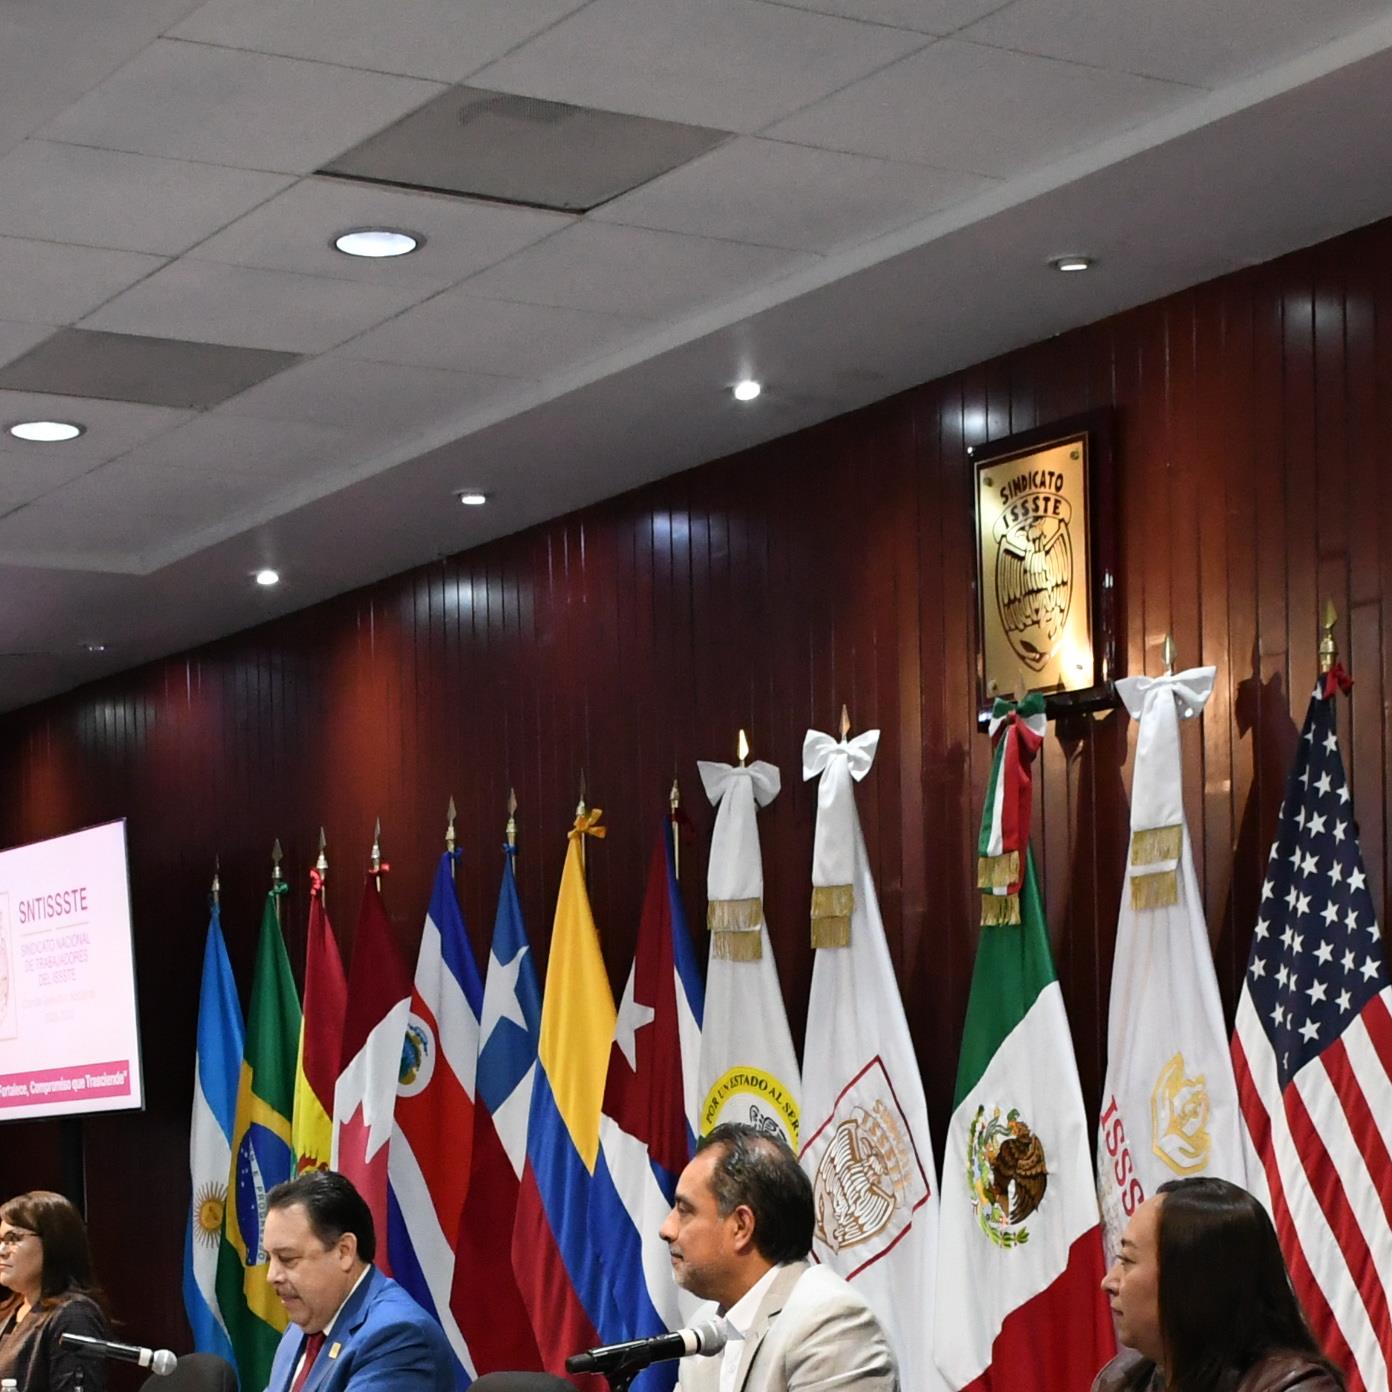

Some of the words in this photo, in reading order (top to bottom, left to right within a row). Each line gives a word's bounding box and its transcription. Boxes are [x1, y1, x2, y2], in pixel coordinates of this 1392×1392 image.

[999, 469, 1064, 505] SINDICATO
[1003, 496, 1062, 529] ISSSTE
[18, 887, 88, 924] SNTISSSTE
[706, 1097, 719, 1124] POR
[729, 1074, 768, 1091] ESTADO
[768, 1087, 782, 1104] AL
